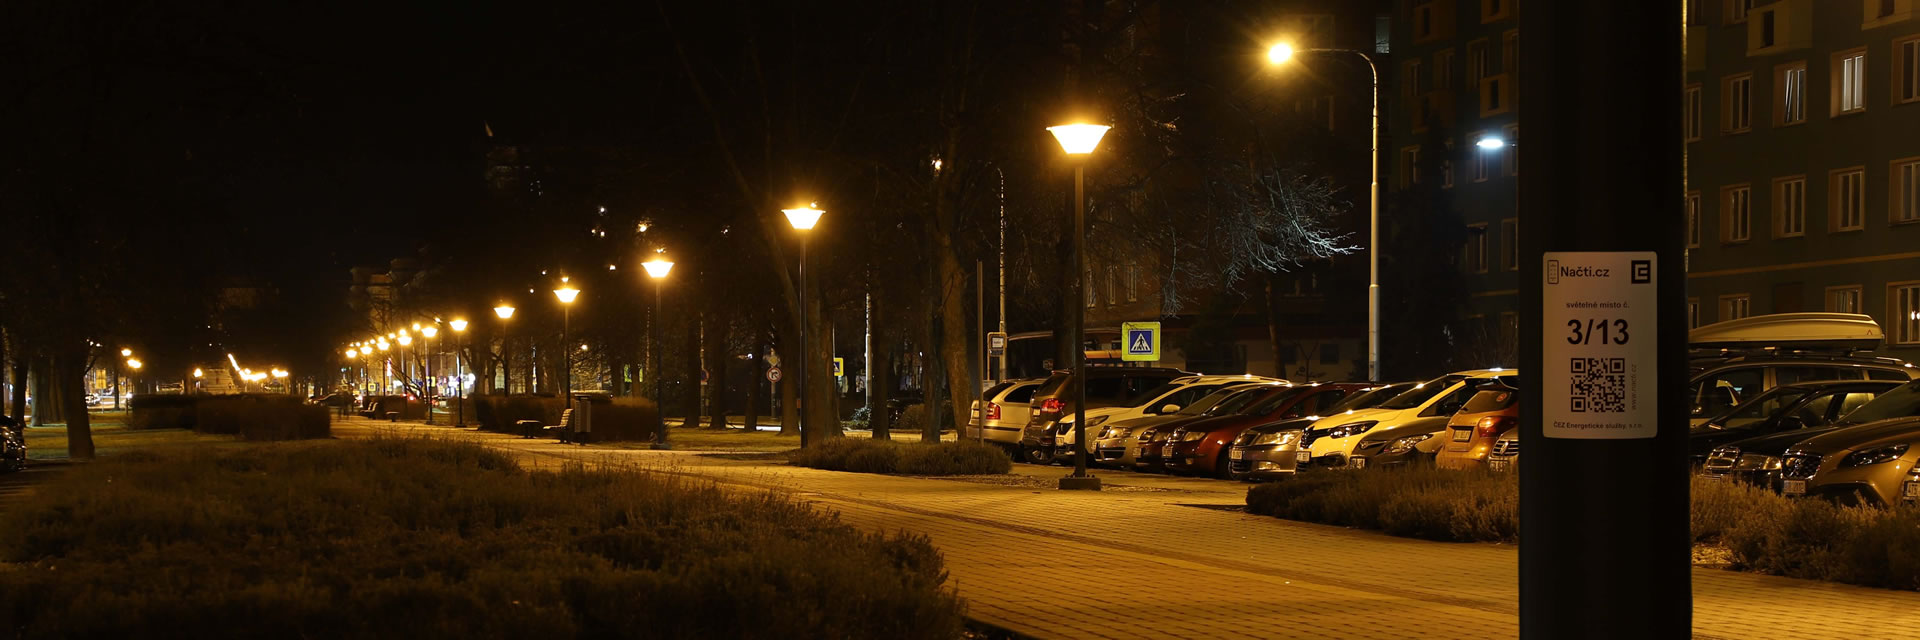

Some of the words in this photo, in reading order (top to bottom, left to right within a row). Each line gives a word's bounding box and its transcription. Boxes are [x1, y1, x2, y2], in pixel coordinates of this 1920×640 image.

[1560, 266, 1610, 277] Načti.cz
[1567, 319, 1630, 345] 3/13
[1553, 420, 1565, 429] ČEZ
